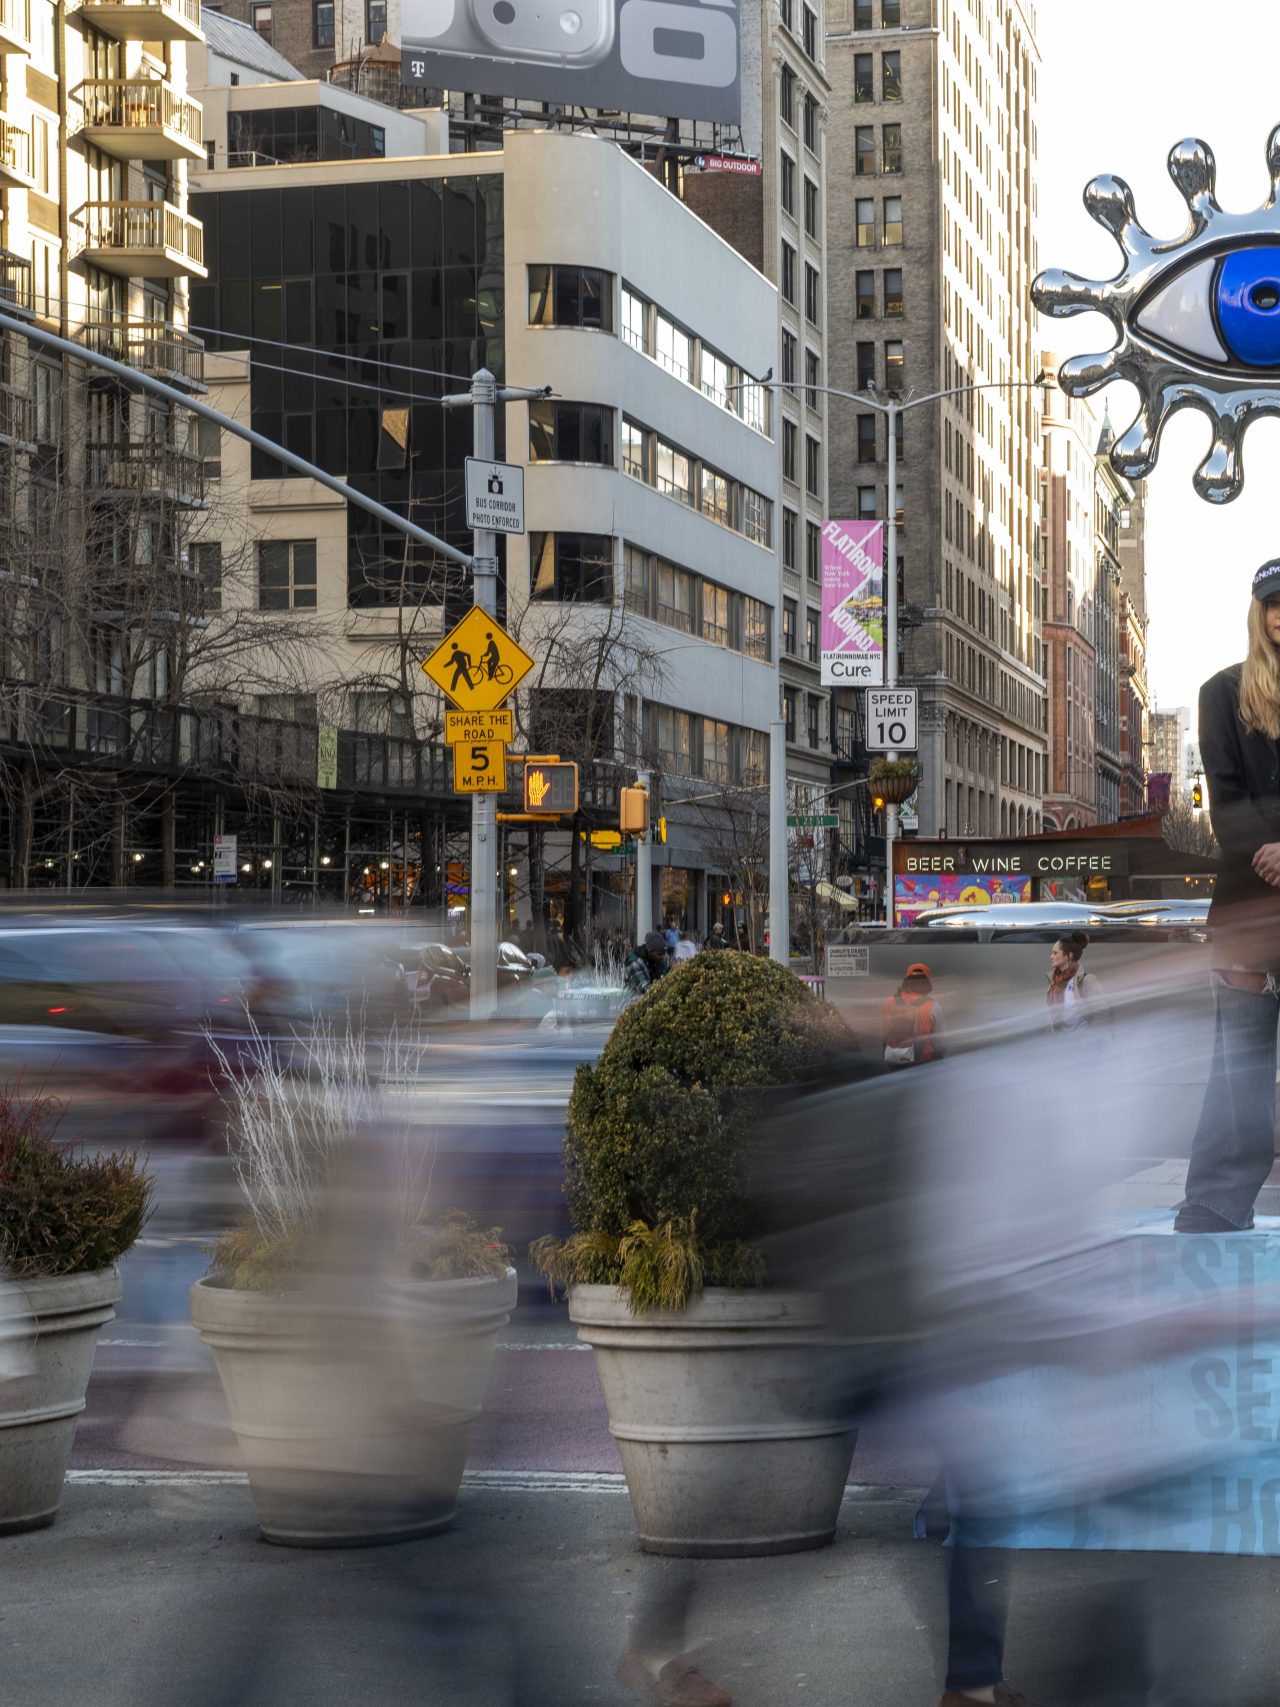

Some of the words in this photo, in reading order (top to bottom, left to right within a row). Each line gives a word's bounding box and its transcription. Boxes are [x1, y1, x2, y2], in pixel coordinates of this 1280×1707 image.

[709, 159, 722, 168] BIG
[722, 161, 757, 172] OUTDOOR
[475, 497, 487, 508] BUS
[488, 498, 516, 513] CORRIDOR
[472, 512, 491, 525] PHOTO
[491, 515, 520, 529] ENFORCED
[822, 521, 882, 580] FLATIRON
[828, 606, 875, 652] NOMAD
[872, 694, 913, 705] SPEED
[449, 715, 485, 727] SHARE
[489, 714, 509, 726] THE
[875, 707, 908, 718] LIMIT
[464, 729, 495, 740] ROAD
[877, 722, 907, 744] 10
[471, 746, 490, 772] 5
[906, 856, 955, 872] BEER
[972, 856, 1021, 872] WINE
[1037, 855, 1112, 871] COFFEE
